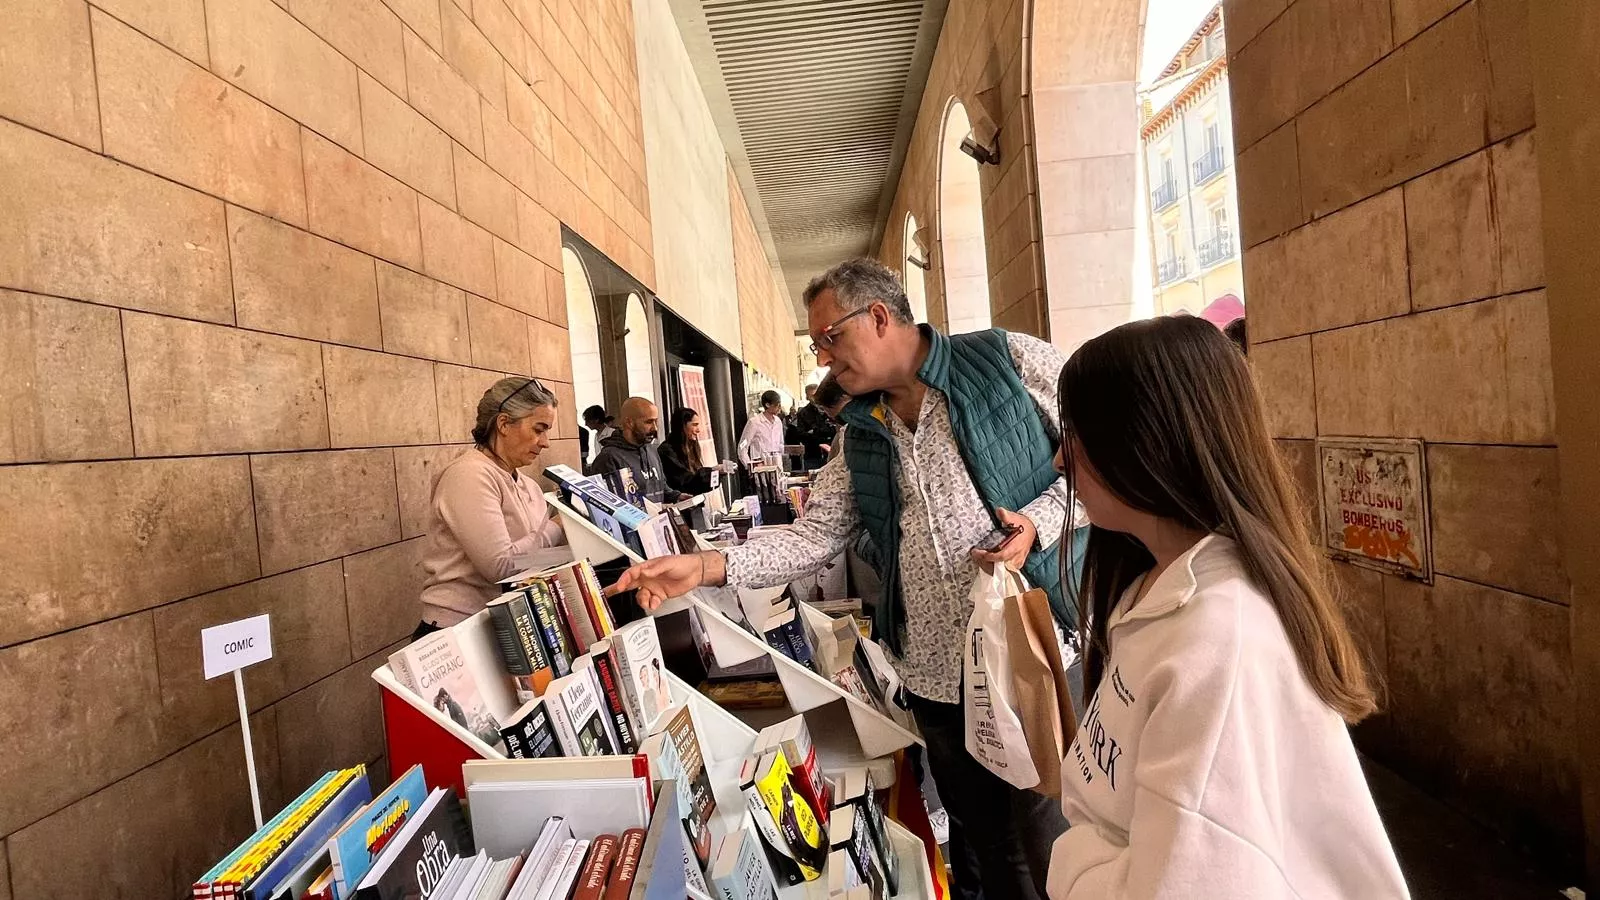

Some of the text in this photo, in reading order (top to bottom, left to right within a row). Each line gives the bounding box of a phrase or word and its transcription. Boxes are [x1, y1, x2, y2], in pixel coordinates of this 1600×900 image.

[1343, 510, 1405, 533] BOMBEROS
[224, 637, 254, 655] COMIC
[516, 617, 522, 626] LA
[520, 628, 534, 656] CONDESA
[522, 614, 546, 668] REYES MONFORTE
[568, 682, 585, 704] Elena
[570, 692, 593, 723] Ferrante
[507, 734, 519, 750] JOËL
[675, 723, 689, 747] JAVIER
[677, 731, 695, 756] ASTILLO
[1084, 692, 1122, 791] YORK
[422, 831, 438, 855] Una
[416, 840, 451, 897] Obra
[745, 852, 756, 887] JAVIER
